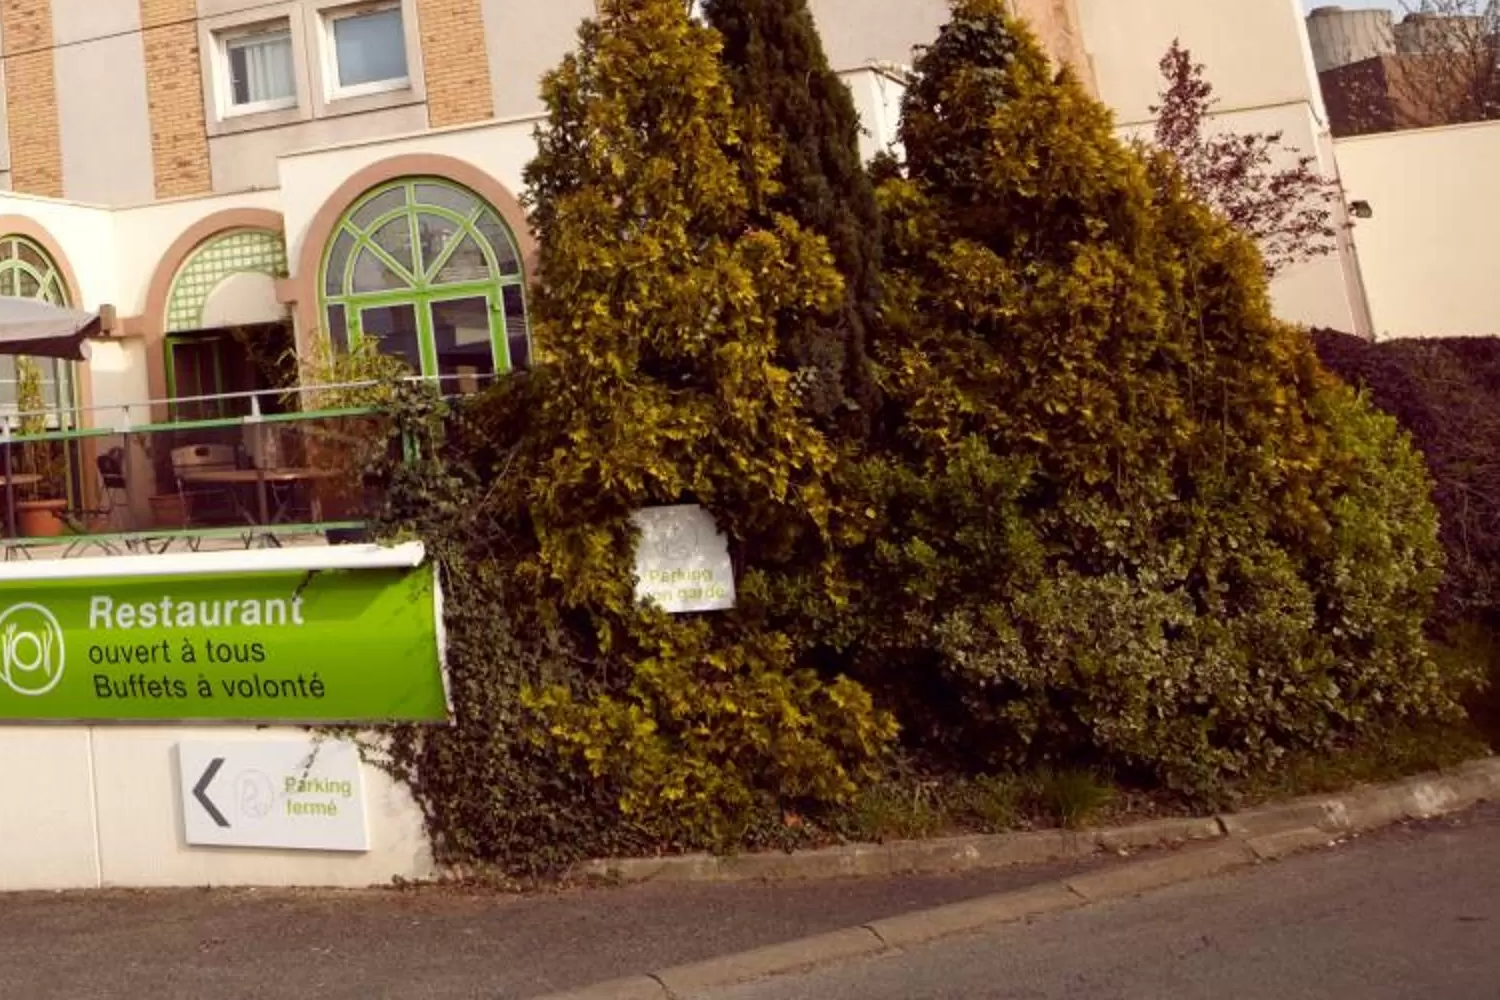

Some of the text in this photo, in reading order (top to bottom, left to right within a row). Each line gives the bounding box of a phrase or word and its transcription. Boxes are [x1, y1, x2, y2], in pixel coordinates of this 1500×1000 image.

[88, 595, 305, 629] Restaurant
[88, 637, 266, 665] ouvert à tous
[93, 672, 325, 699] Buffets à volonté
[284, 776, 352, 798] Parking
[286, 799, 338, 816] fermé
